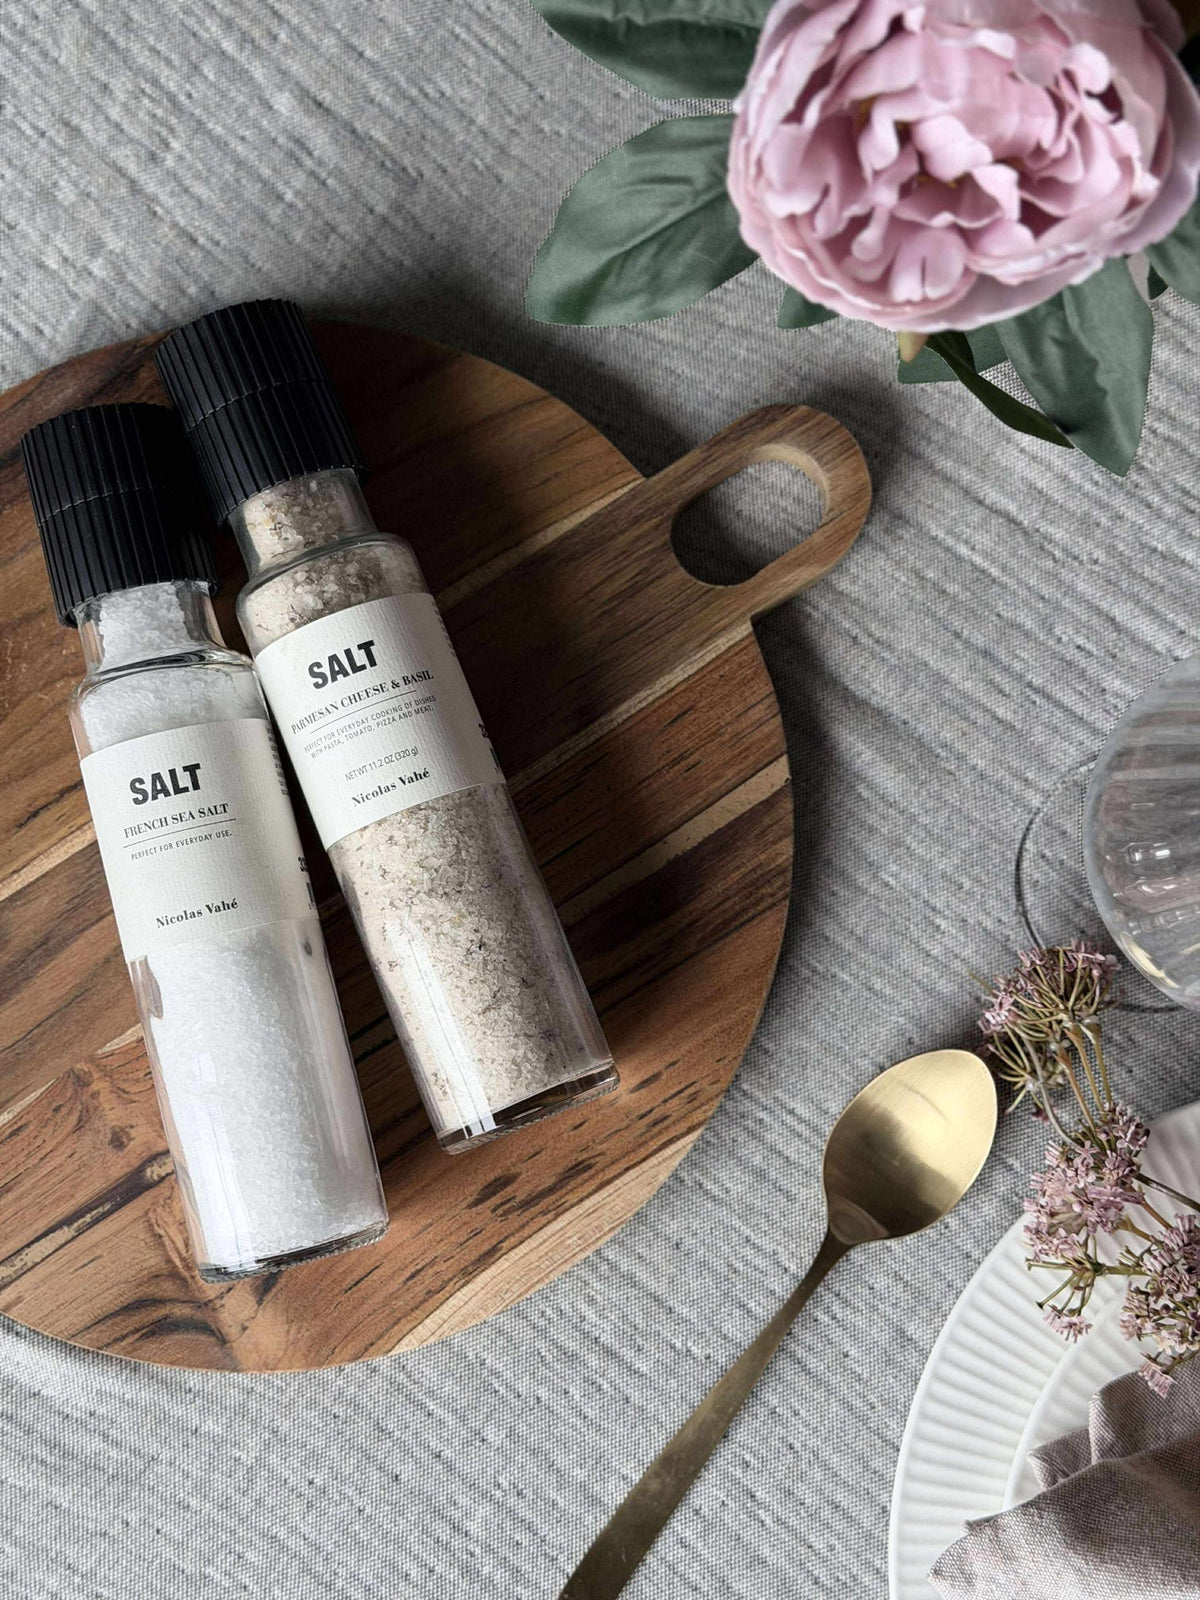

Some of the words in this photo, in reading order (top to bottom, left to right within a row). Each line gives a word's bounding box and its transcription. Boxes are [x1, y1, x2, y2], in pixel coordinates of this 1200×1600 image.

[308, 640, 377, 689] SALT
[291, 701, 340, 734] PARMESAN
[340, 683, 389, 709] CHEESE
[391, 680, 400, 690] &
[402, 670, 434, 686] BASIL
[304, 738, 323, 753] PERFECT
[324, 730, 335, 742] FOR
[336, 718, 369, 736] EVERYDAY
[371, 705, 403, 721] COOKING
[404, 702, 413, 710] OF
[415, 696, 437, 706] DISHES
[323, 739, 344, 752] PASTA,
[376, 715, 396, 728] PIZZA
[398, 711, 413, 721] AND
[368, 759, 384, 773] 11.2
[384, 754, 395, 764] OZ
[395, 749, 410, 762] (320
[129, 763, 201, 805] SALT
[351, 782, 397, 807] Nicolas
[398, 768, 431, 786] Vahé
[123, 817, 169, 838] FRENCH
[171, 810, 195, 824] SEA
[198, 803, 229, 818] SALT
[131, 847, 157, 860] PERFECT
[159, 843, 173, 852] FOR
[176, 833, 213, 848] EVERYDAY
[216, 830, 232, 838] USE.
[156, 908, 203, 928] Nicolas
[205, 898, 238, 914] Vahé
